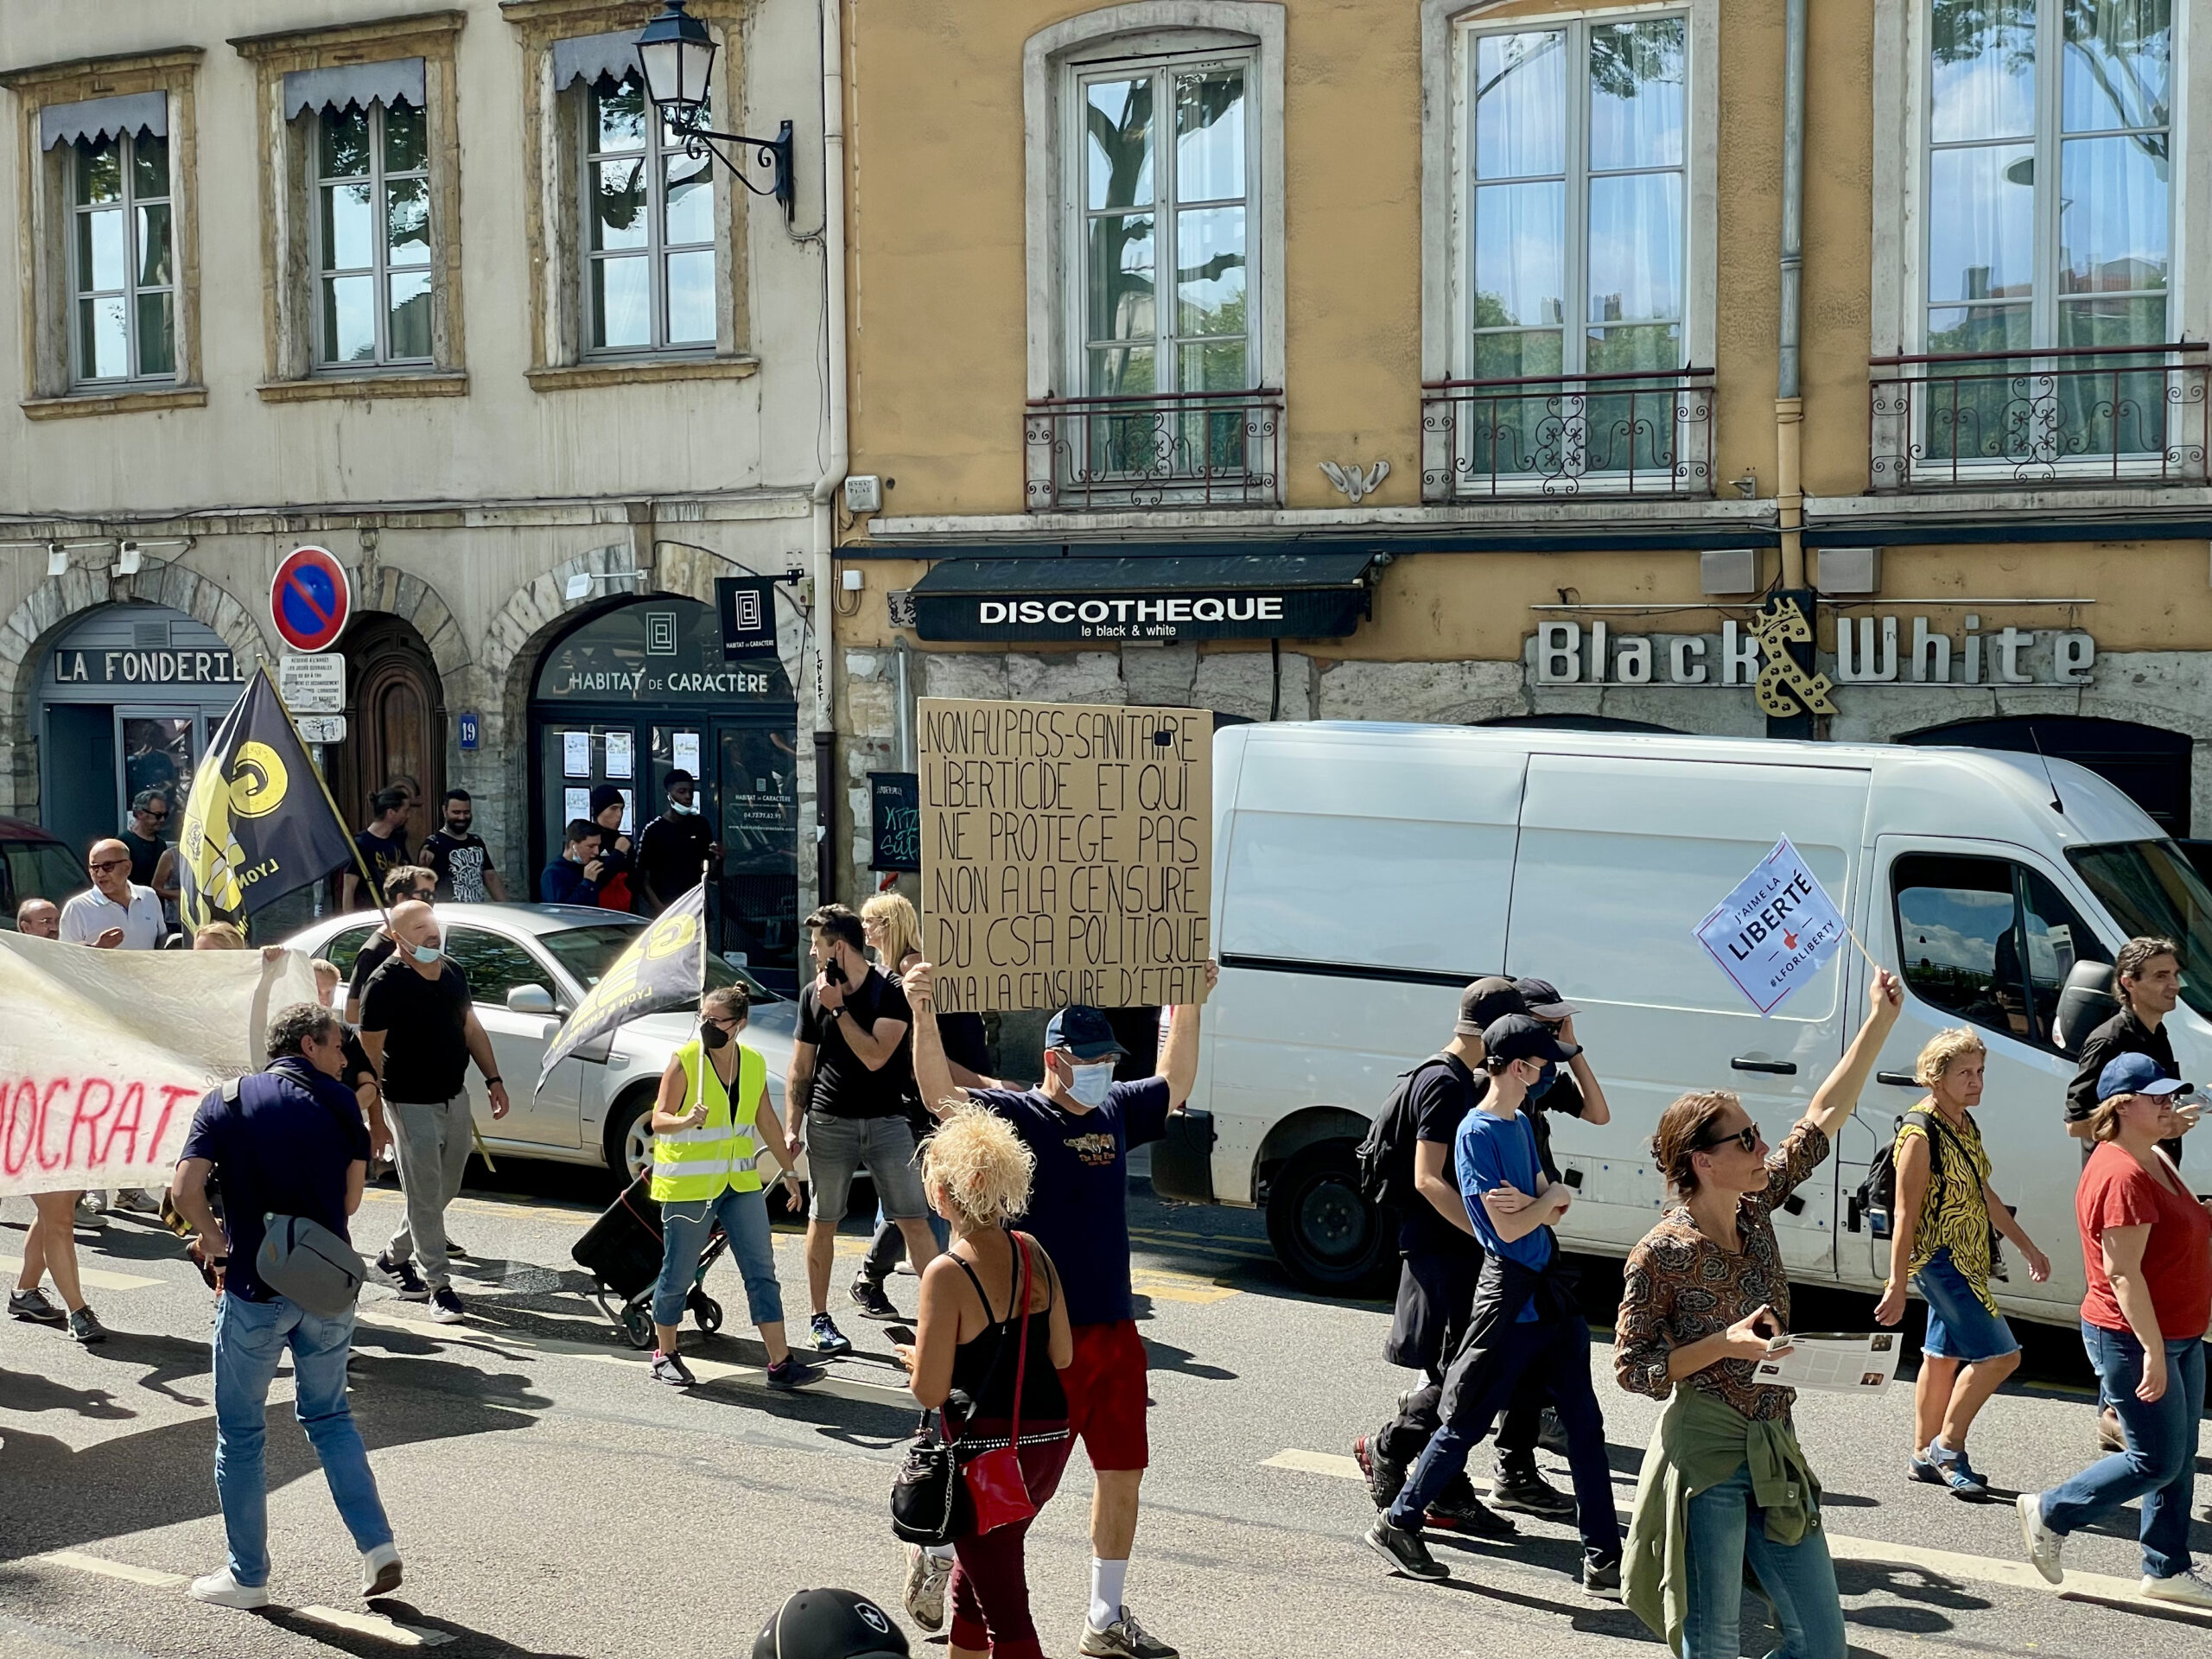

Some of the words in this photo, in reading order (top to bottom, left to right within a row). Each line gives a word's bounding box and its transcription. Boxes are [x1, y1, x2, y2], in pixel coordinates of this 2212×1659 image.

[980, 597, 1283, 624] DISCOTHEQUE
[1081, 625, 1091, 637] le
[1096, 625, 1126, 637] black
[1131, 626, 1141, 637] &
[1146, 624, 1176, 637] white
[56, 652, 88, 681] LA
[1538, 620, 1759, 683] Black
[1837, 614, 2094, 683] White
[571, 672, 641, 690] HABITAT
[648, 679, 663, 690] DE
[668, 671, 767, 692] CARACTÈRE
[462, 722, 475, 741] 19
[1097, 763, 1130, 811] ET
[1138, 762, 1188, 812] QUI
[939, 811, 973, 860] NE
[989, 812, 1119, 863] PROTEGE
[1139, 815, 1198, 863] PAS
[1070, 866, 1200, 914] CENSURE
[1734, 889, 1767, 925] J'AIME
[1766, 877, 1781, 892] LA
[1728, 868, 1812, 961] LIBERTÉ
[938, 918, 972, 968] DU
[987, 914, 1054, 966] CSA
[1068, 914, 1207, 964] POLITIQUE
[1770, 919, 1834, 988] #LFORLIBERTY
[966, 976, 976, 1011] A
[985, 974, 1011, 1010] LA
[1020, 969, 1107, 1009] CENSURE
[1120, 966, 1203, 1008] D'ETAT
